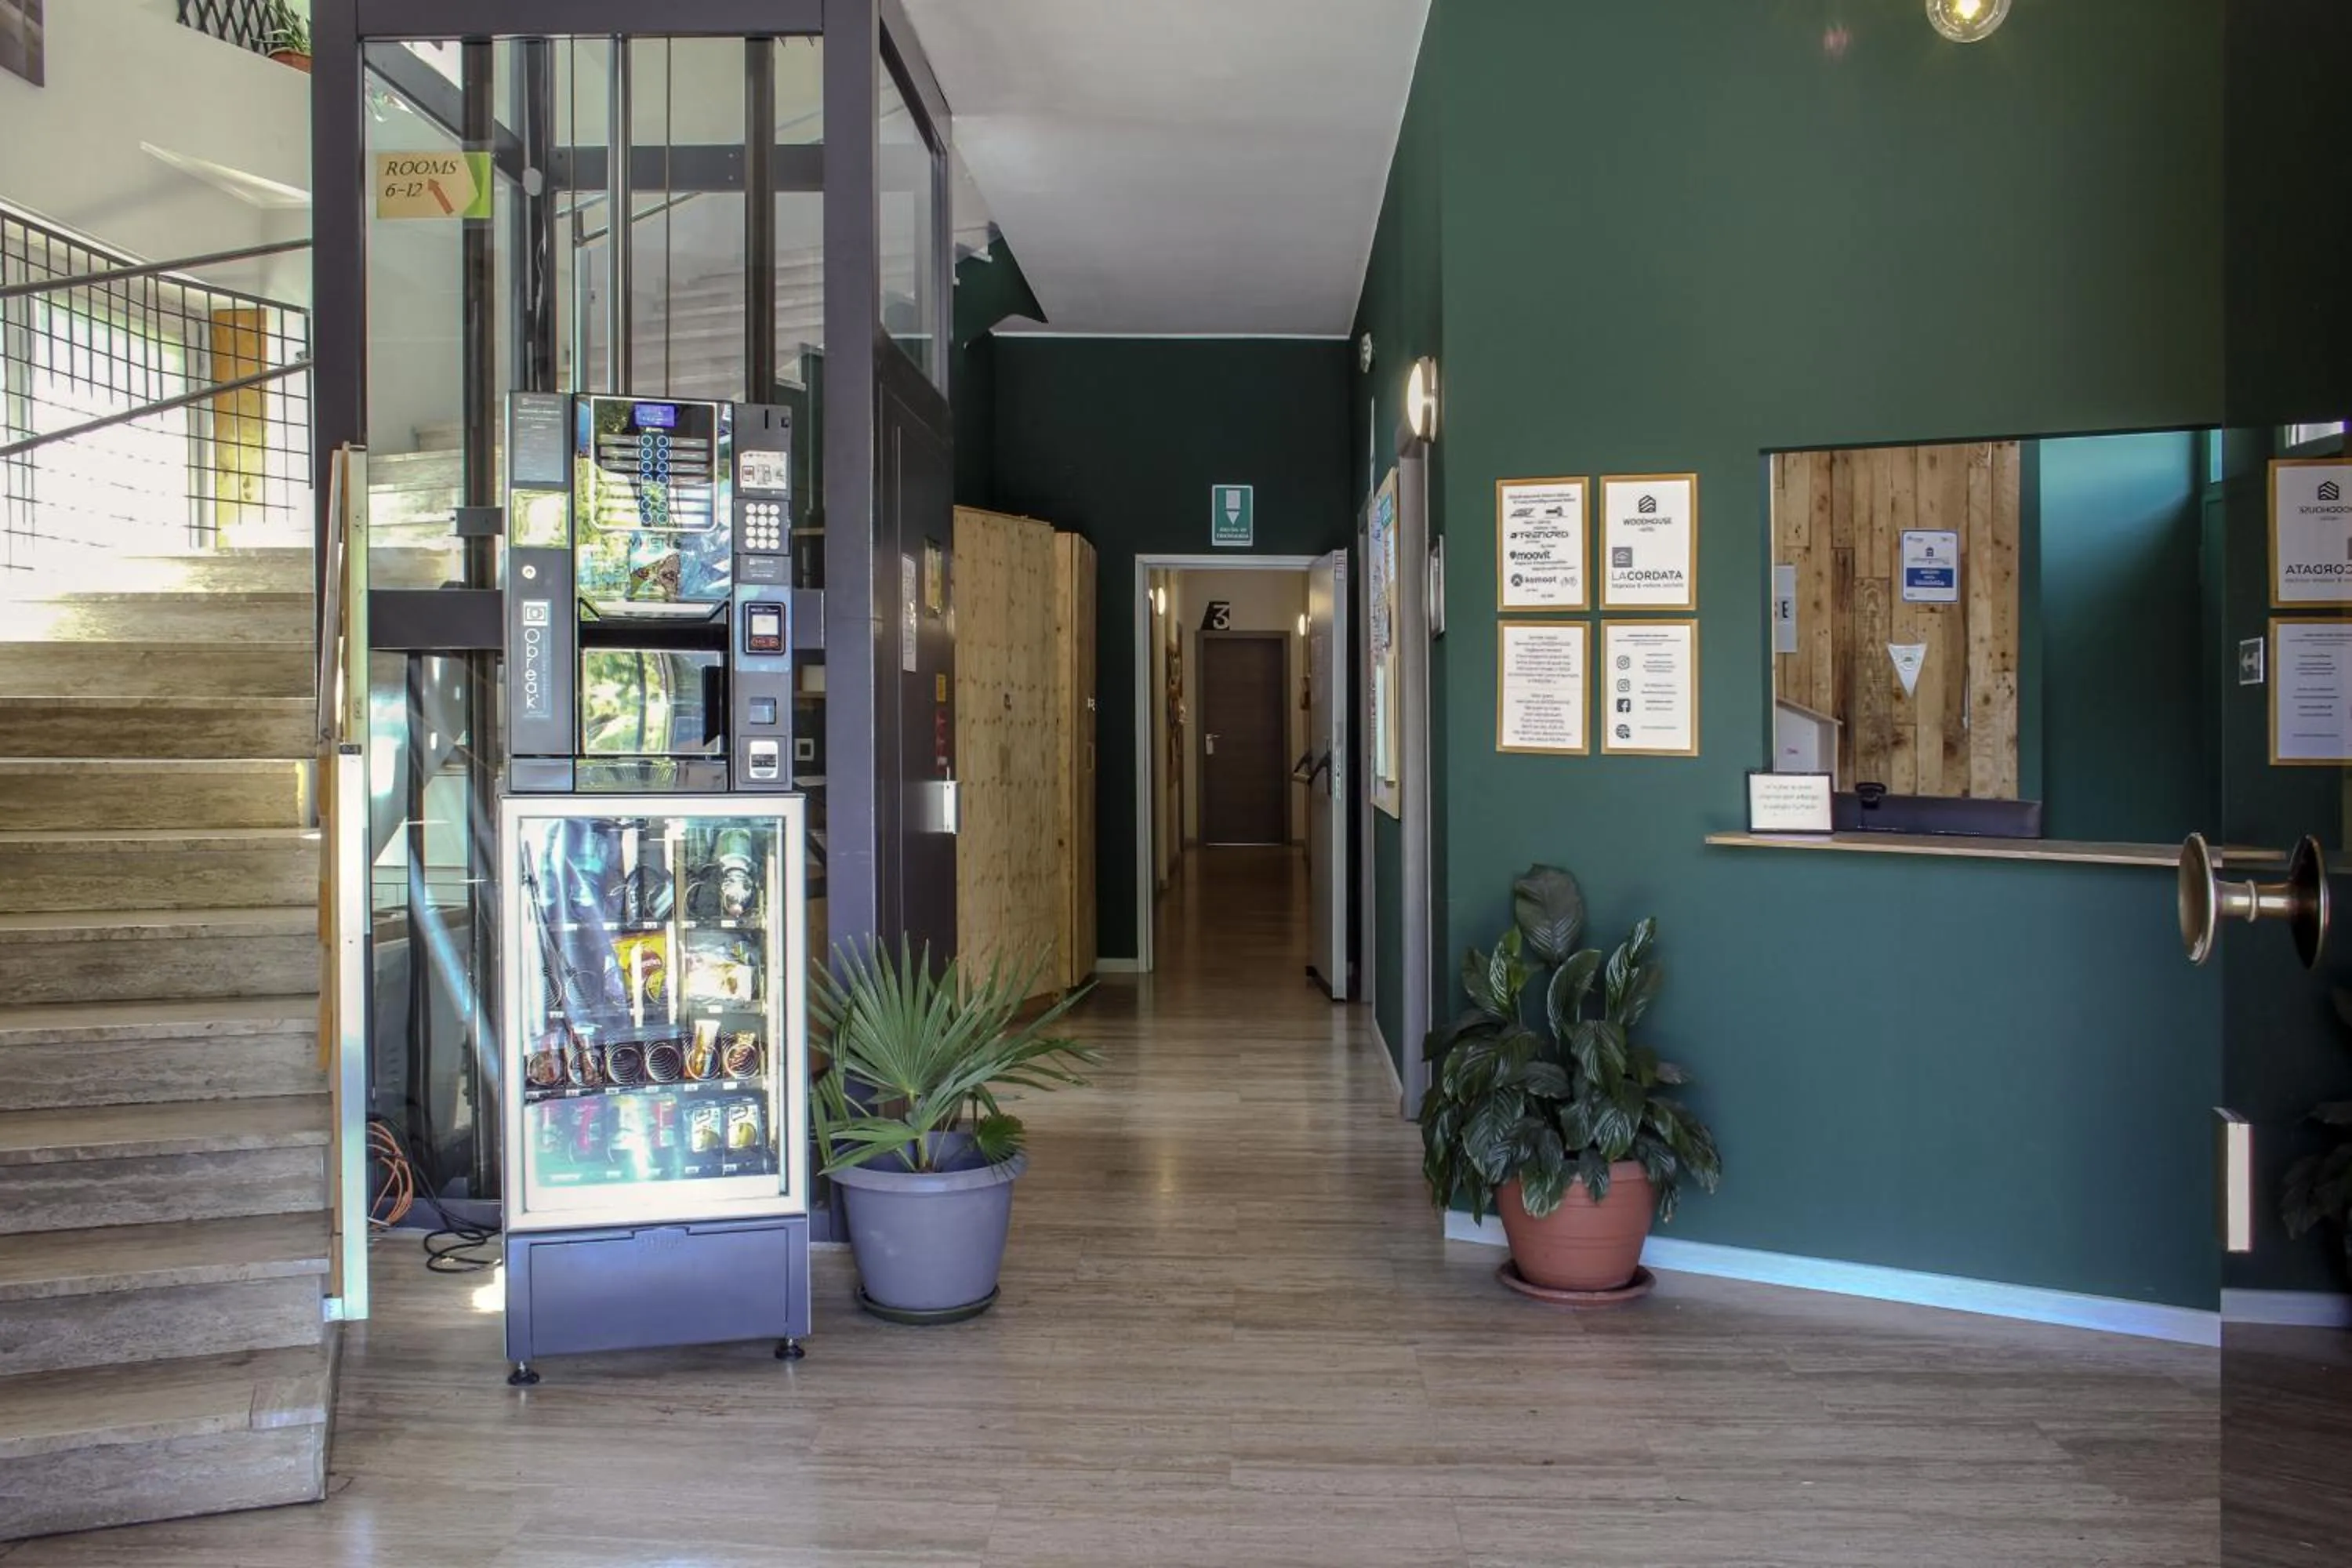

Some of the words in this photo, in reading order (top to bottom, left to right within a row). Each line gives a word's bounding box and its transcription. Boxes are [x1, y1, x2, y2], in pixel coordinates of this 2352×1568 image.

[384, 159, 459, 176] ROOMS
[385, 182, 423, 198] 6-12
[1623, 517, 1672, 526] WOODHOUSE
[1517, 551, 1550, 560] moovit
[1213, 604, 1230, 630] 3
